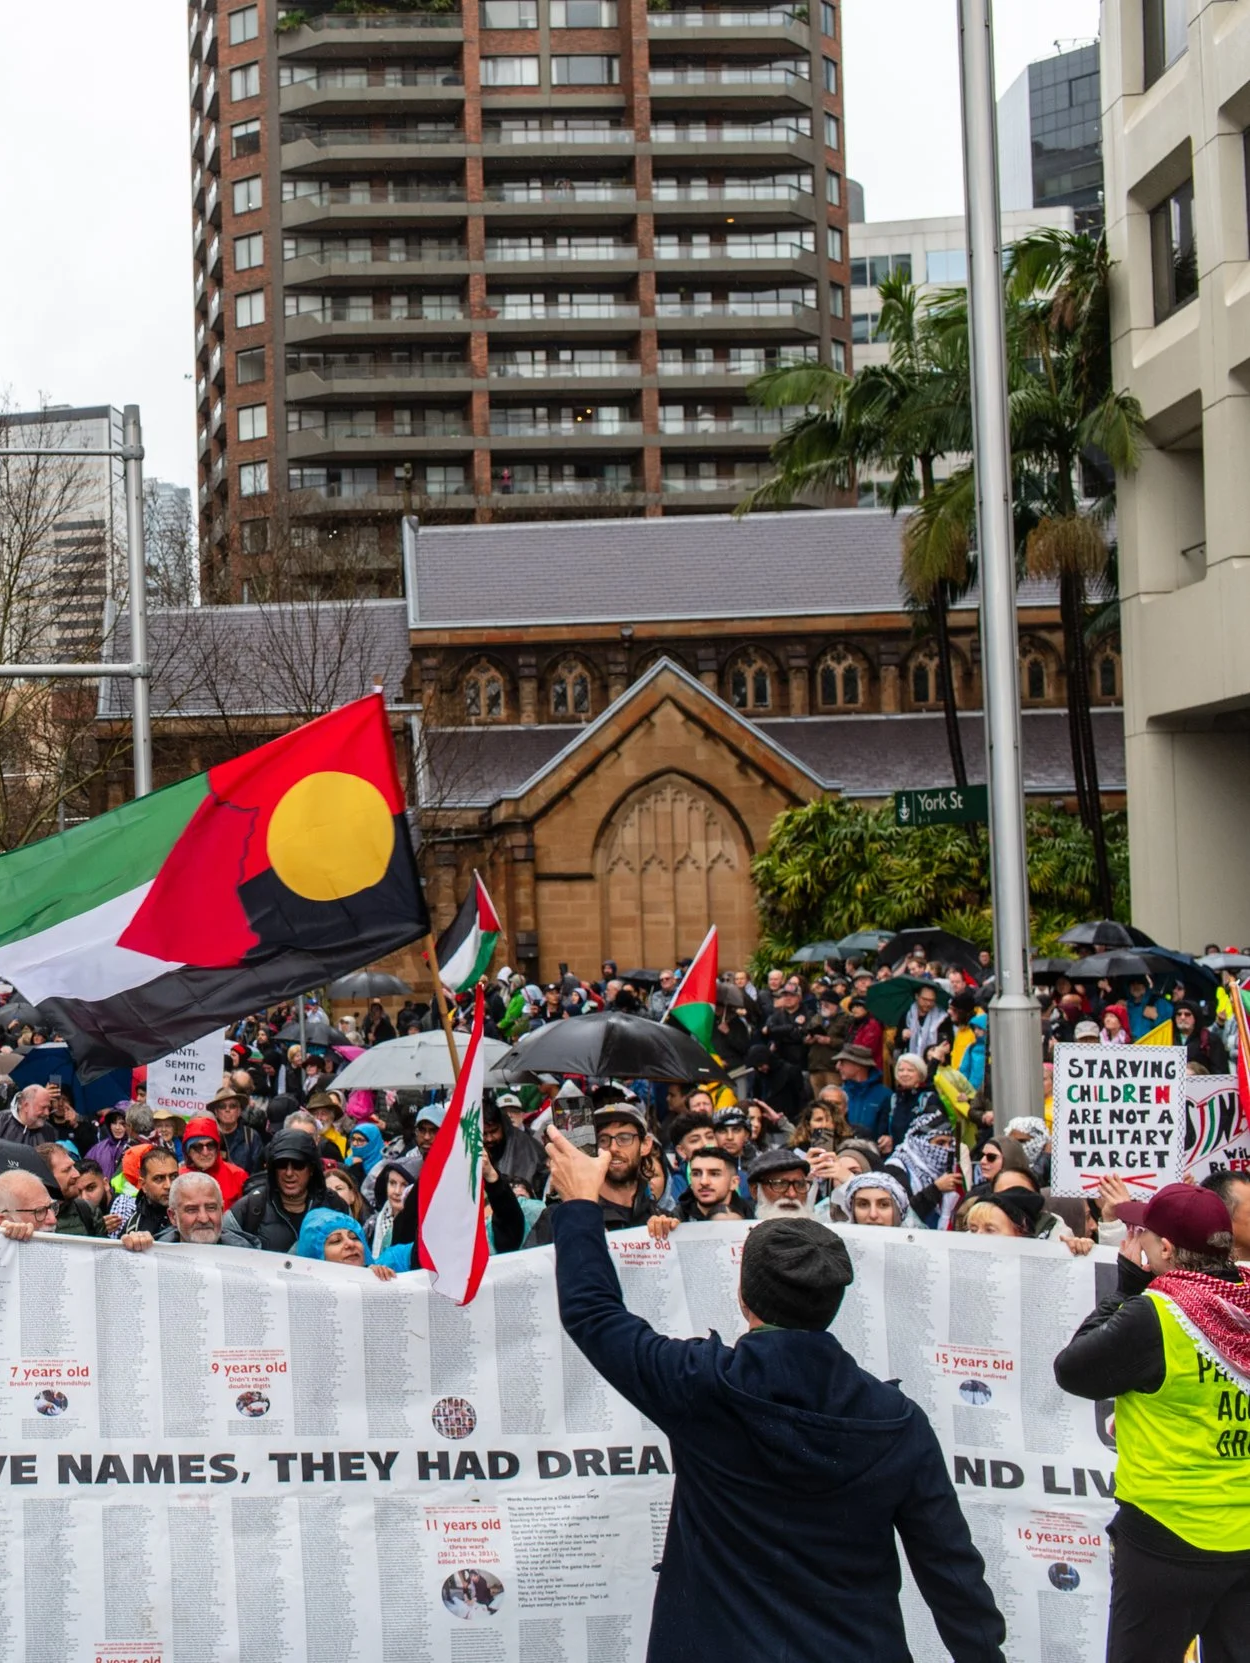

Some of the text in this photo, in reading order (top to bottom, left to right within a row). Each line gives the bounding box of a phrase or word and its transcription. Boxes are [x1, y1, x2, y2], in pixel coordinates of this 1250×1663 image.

[918, 791, 963, 811] York St
[165, 1060, 206, 1071] SEMITIC
[1068, 1058, 1176, 1079] STARVING
[179, 1074, 195, 1083] AM
[171, 1086, 198, 1096] ANTI-
[1067, 1083, 1170, 1104] CHILDREN
[158, 1097, 207, 1110] GENOCID
[1068, 1108, 1174, 1124] ARE NOT A
[1070, 1129, 1174, 1146] MILITARY
[1070, 1150, 1170, 1168] TARGET
[608, 1240, 670, 1252] 2 years old
[212, 1362, 287, 1376] 9 years old
[936, 1352, 1013, 1370] 15 years old
[10, 1366, 89, 1380] 7 years old
[1218, 1390, 1250, 1421] AC
[1216, 1430, 1250, 1456] GR
[58, 1453, 250, 1484] NAMES,
[268, 1452, 399, 1482] THEY
[417, 1450, 520, 1481] HAD
[537, 1446, 676, 1480] DREA
[954, 1455, 1024, 1489] ND
[1042, 1465, 1116, 1498] LIV
[426, 1519, 501, 1534] 11 years old
[1018, 1528, 1101, 1546] 16 years old
